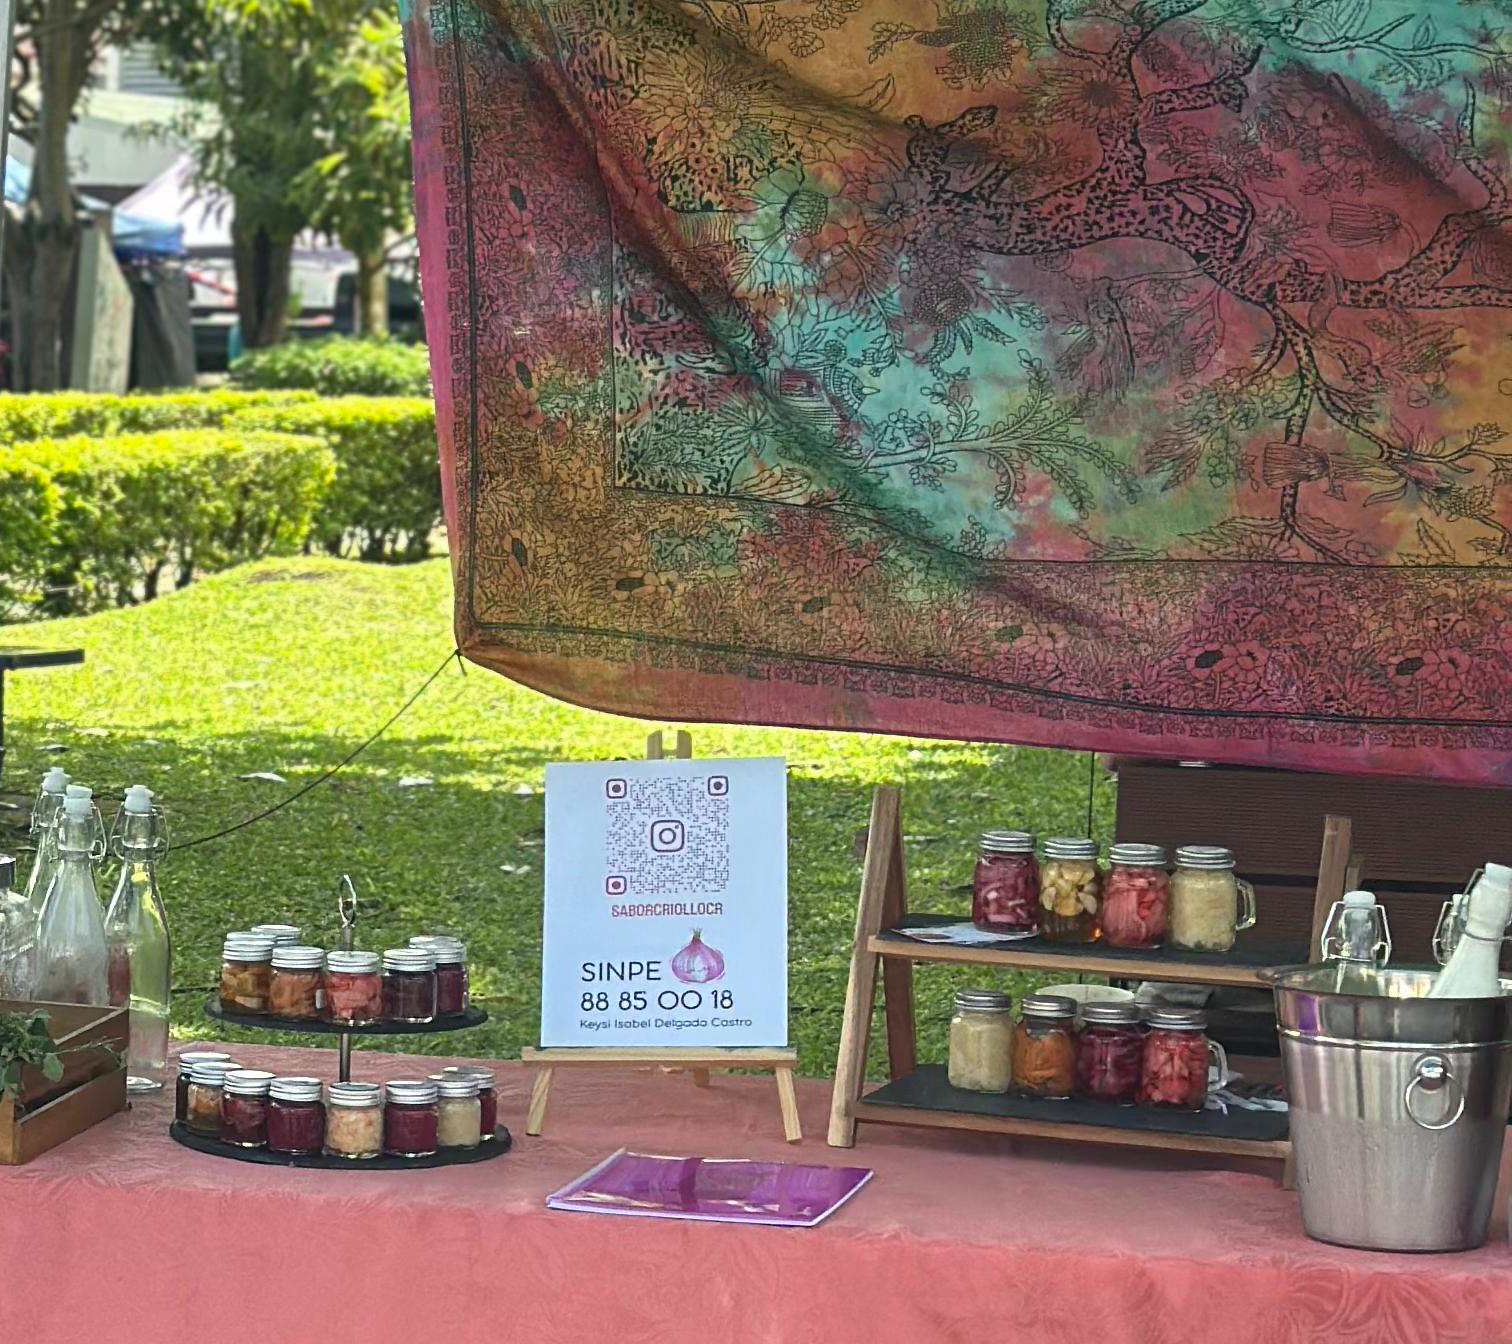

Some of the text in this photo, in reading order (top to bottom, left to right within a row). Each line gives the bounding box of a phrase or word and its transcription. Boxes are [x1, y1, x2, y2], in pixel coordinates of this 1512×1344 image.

[611, 902, 724, 918] SABORCRIOLLOCR
[581, 961, 662, 982] SINPE
[580, 991, 609, 1012] 88
[618, 990, 647, 1011] 85
[711, 989, 734, 1009] 18
[580, 1017, 753, 1031] Keysi Isabel Delgado Castro
